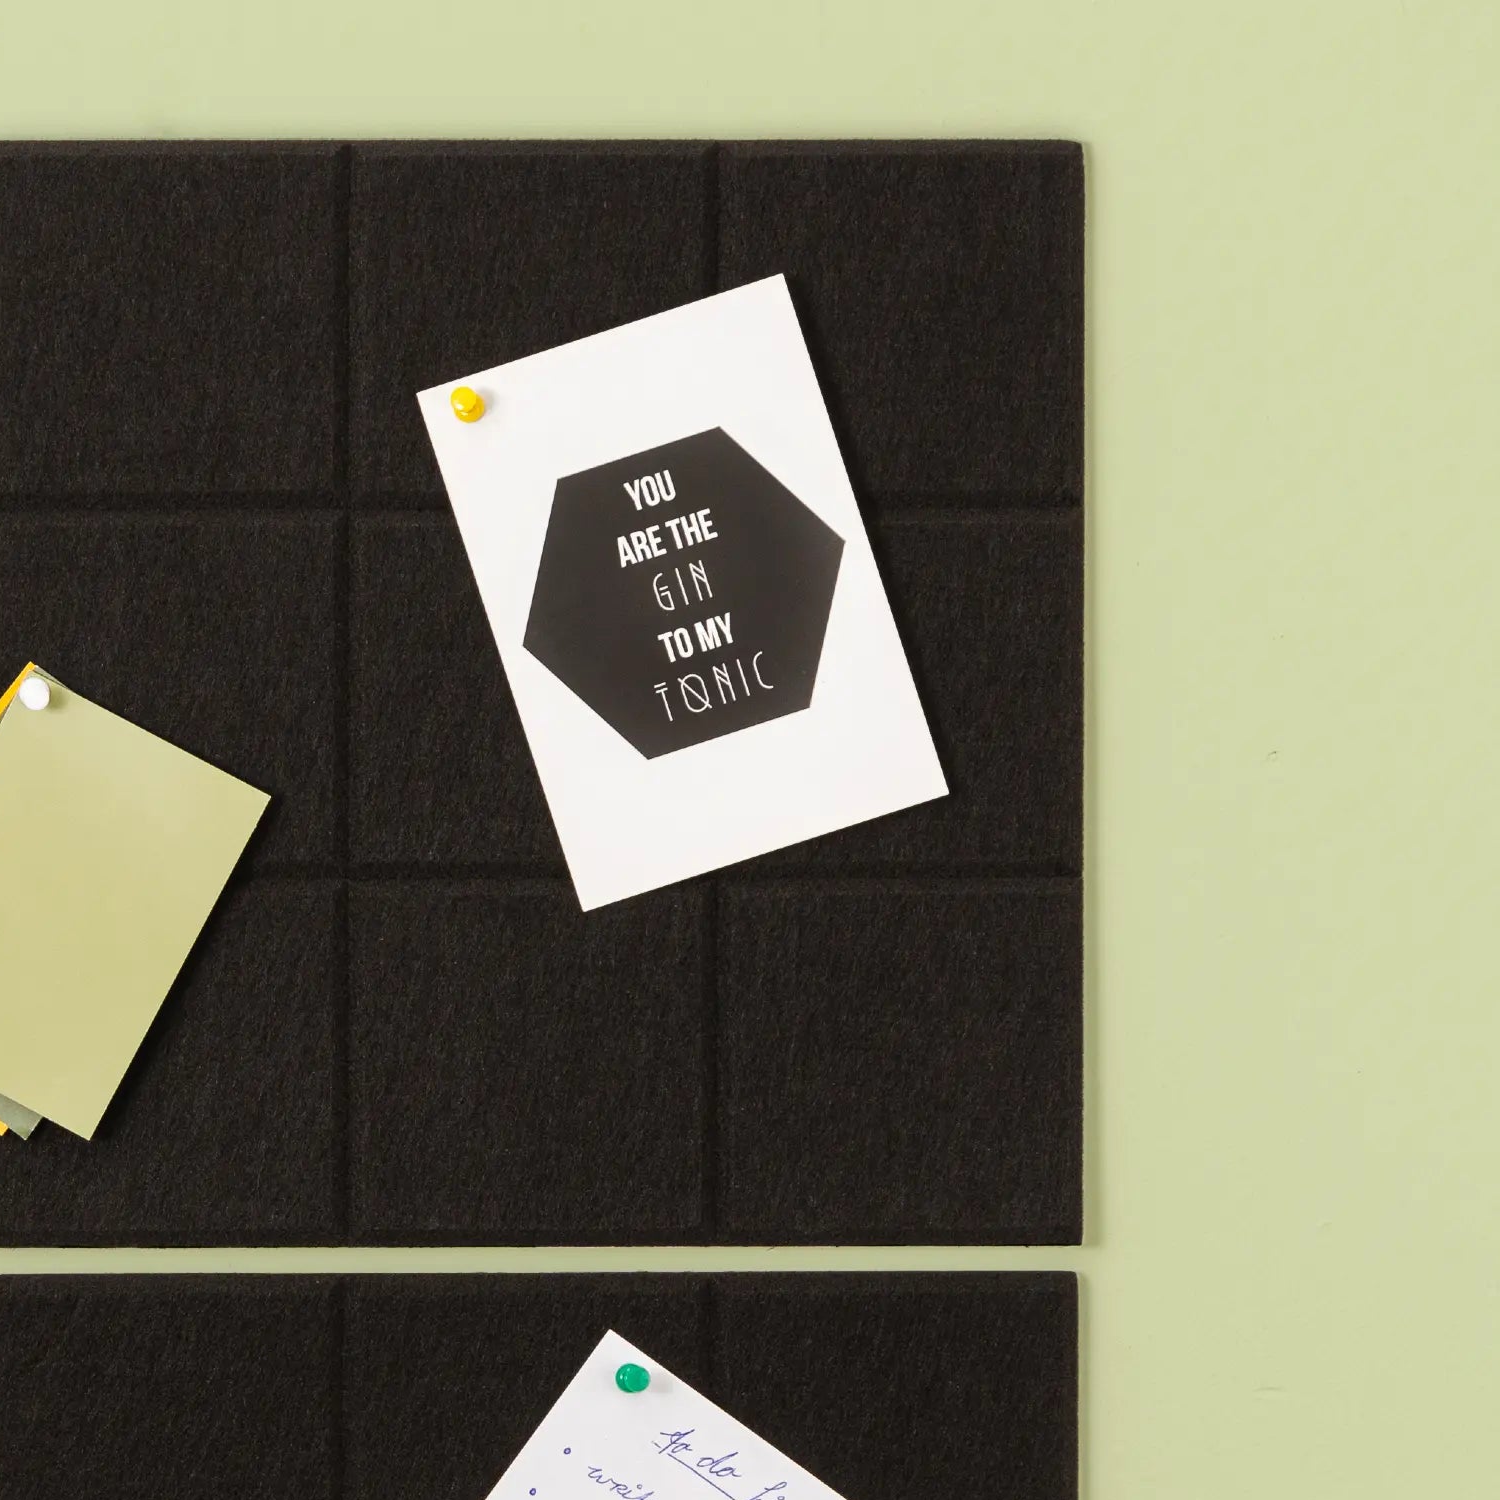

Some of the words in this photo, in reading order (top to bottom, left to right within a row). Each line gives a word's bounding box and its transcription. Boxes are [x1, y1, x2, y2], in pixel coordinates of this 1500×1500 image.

[623, 470, 676, 511] YOU
[616, 525, 667, 568] ARE
[665, 508, 718, 549] THE
[653, 560, 713, 611] GIN
[658, 627, 694, 663] TO
[695, 612, 734, 653] MY
[654, 651, 774, 722] TONIC
[696, 1451, 742, 1479] do
